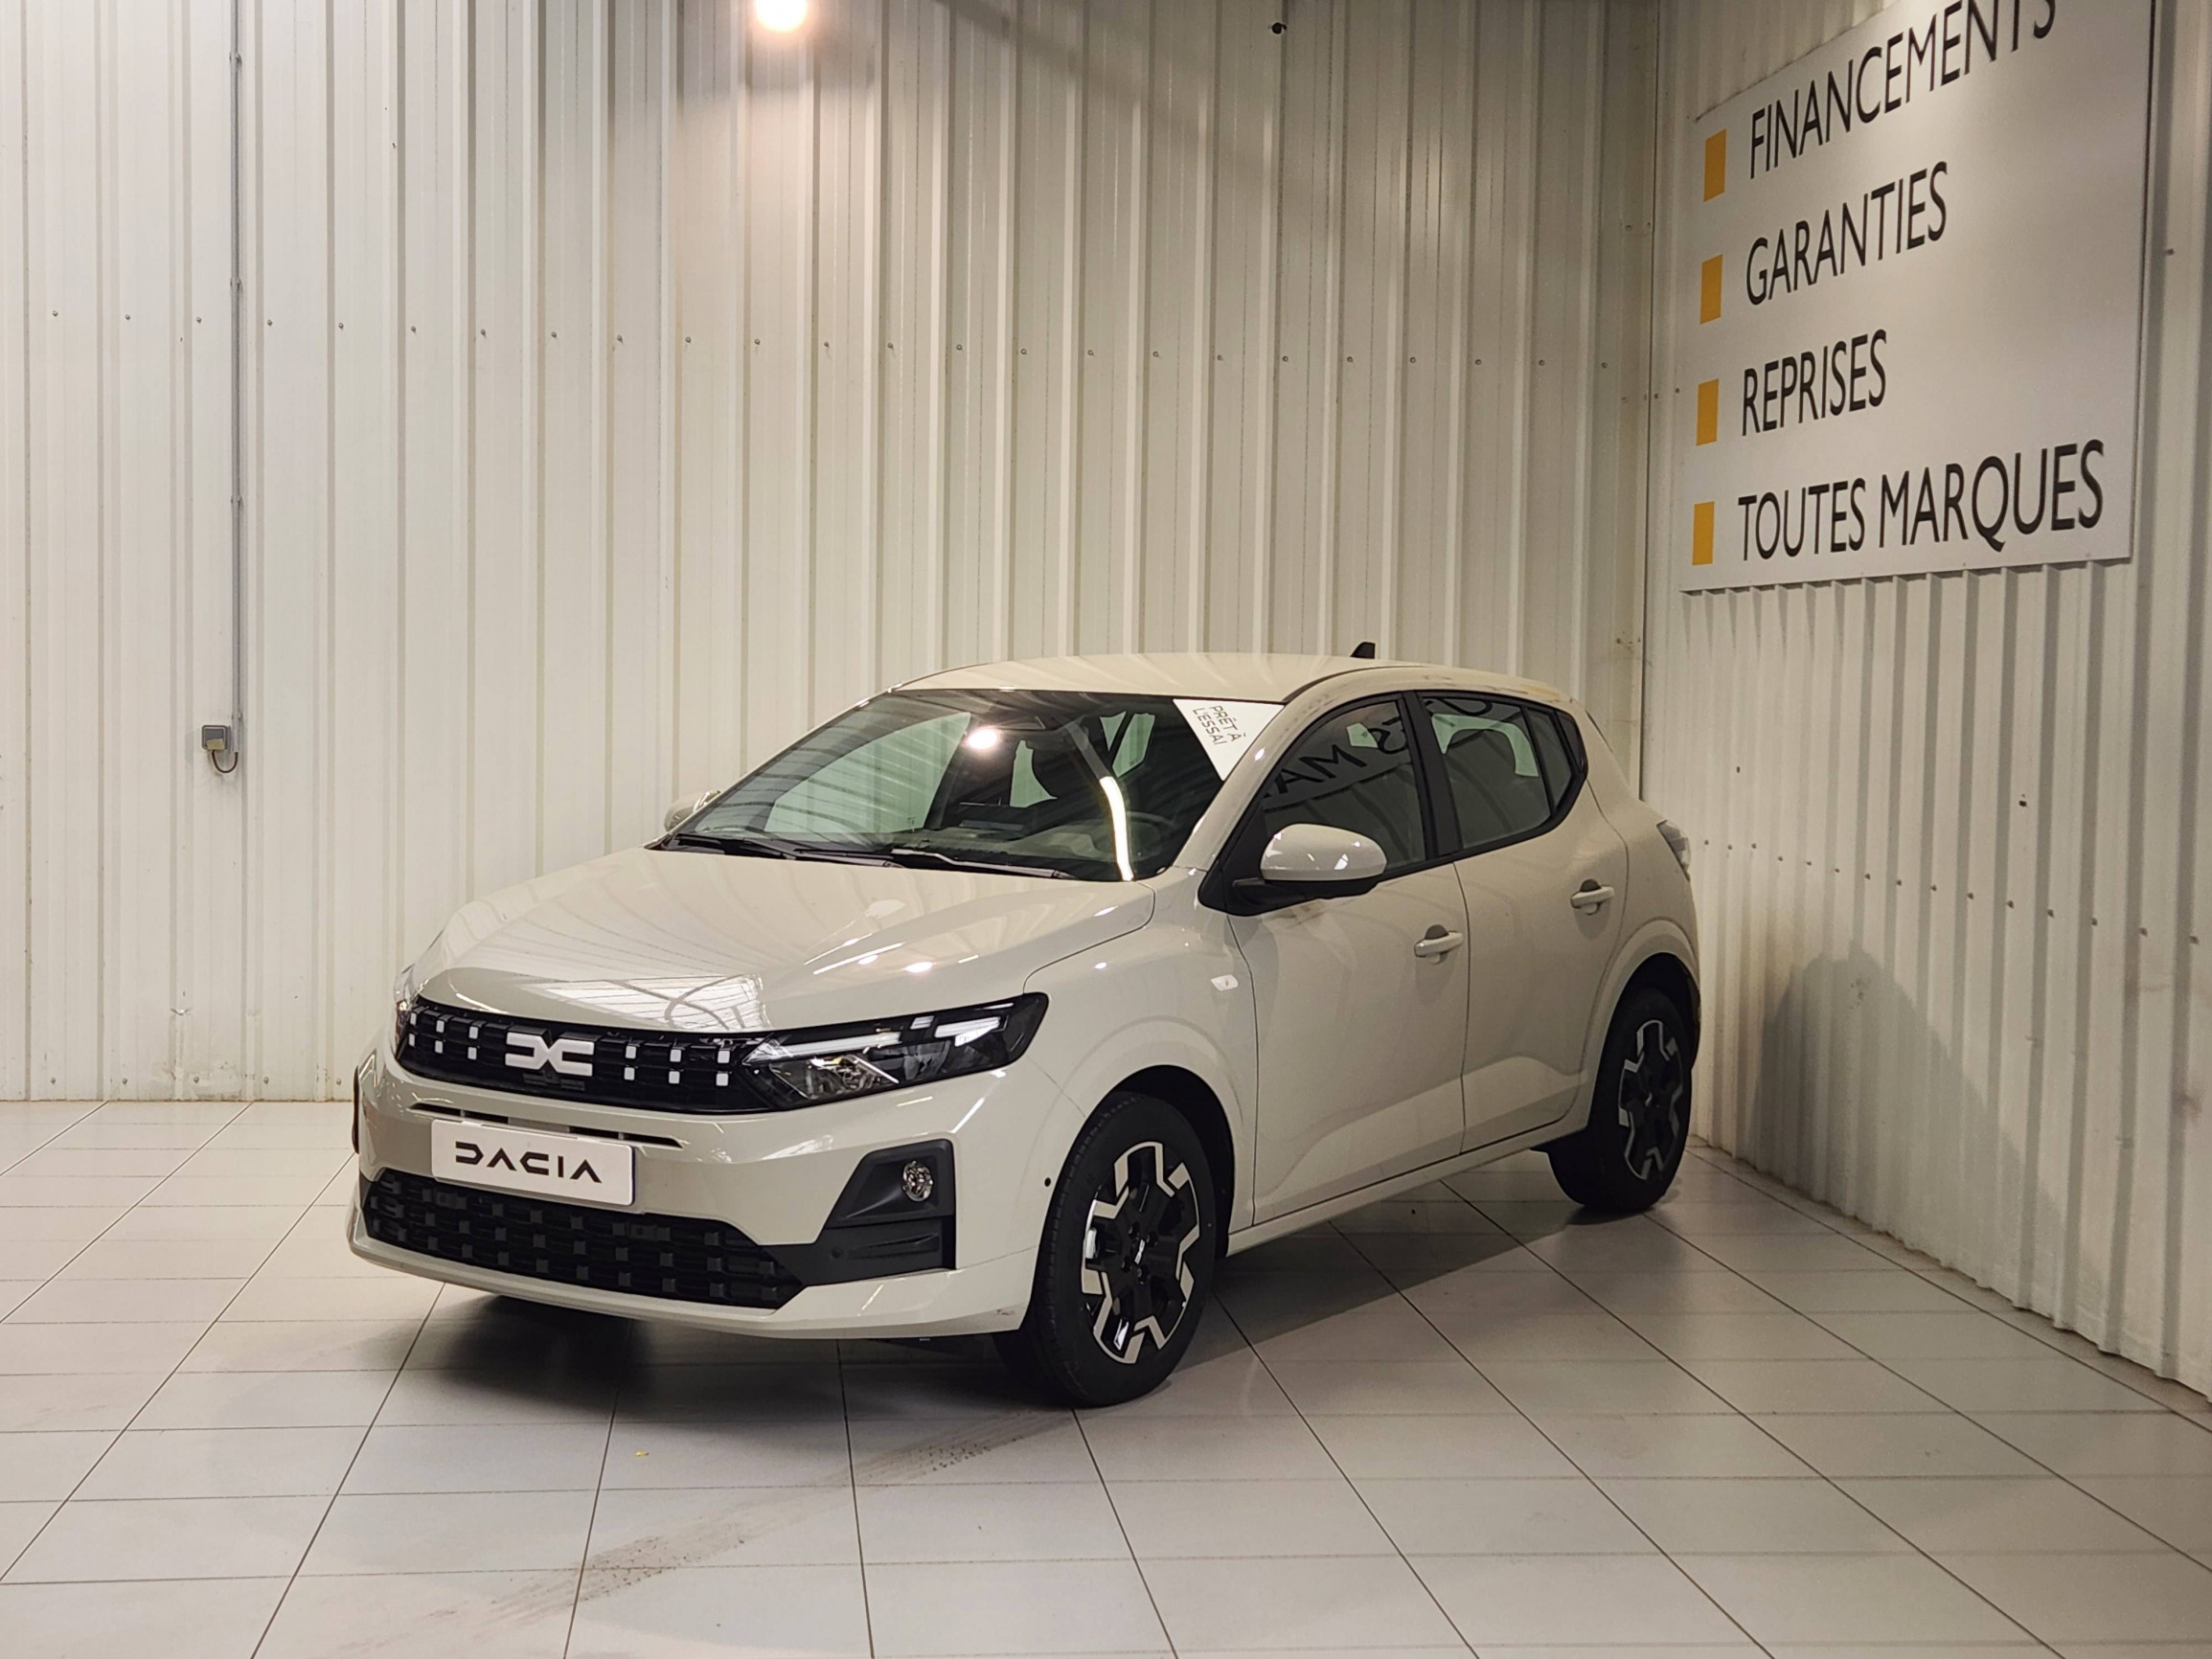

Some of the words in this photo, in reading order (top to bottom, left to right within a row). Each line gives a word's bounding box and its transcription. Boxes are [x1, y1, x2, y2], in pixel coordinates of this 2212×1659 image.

[1745, 161, 1948, 306] GARANTIES
[1742, 329, 1887, 436] REPRISES
[1738, 477, 1866, 560] TOUTES
[1880, 439, 2105, 553] MARQUES
[1193, 708, 1227, 744] L'ESSAI
[1210, 705, 1238, 730] PRÊT
[455, 1140, 603, 1184] DACIA
